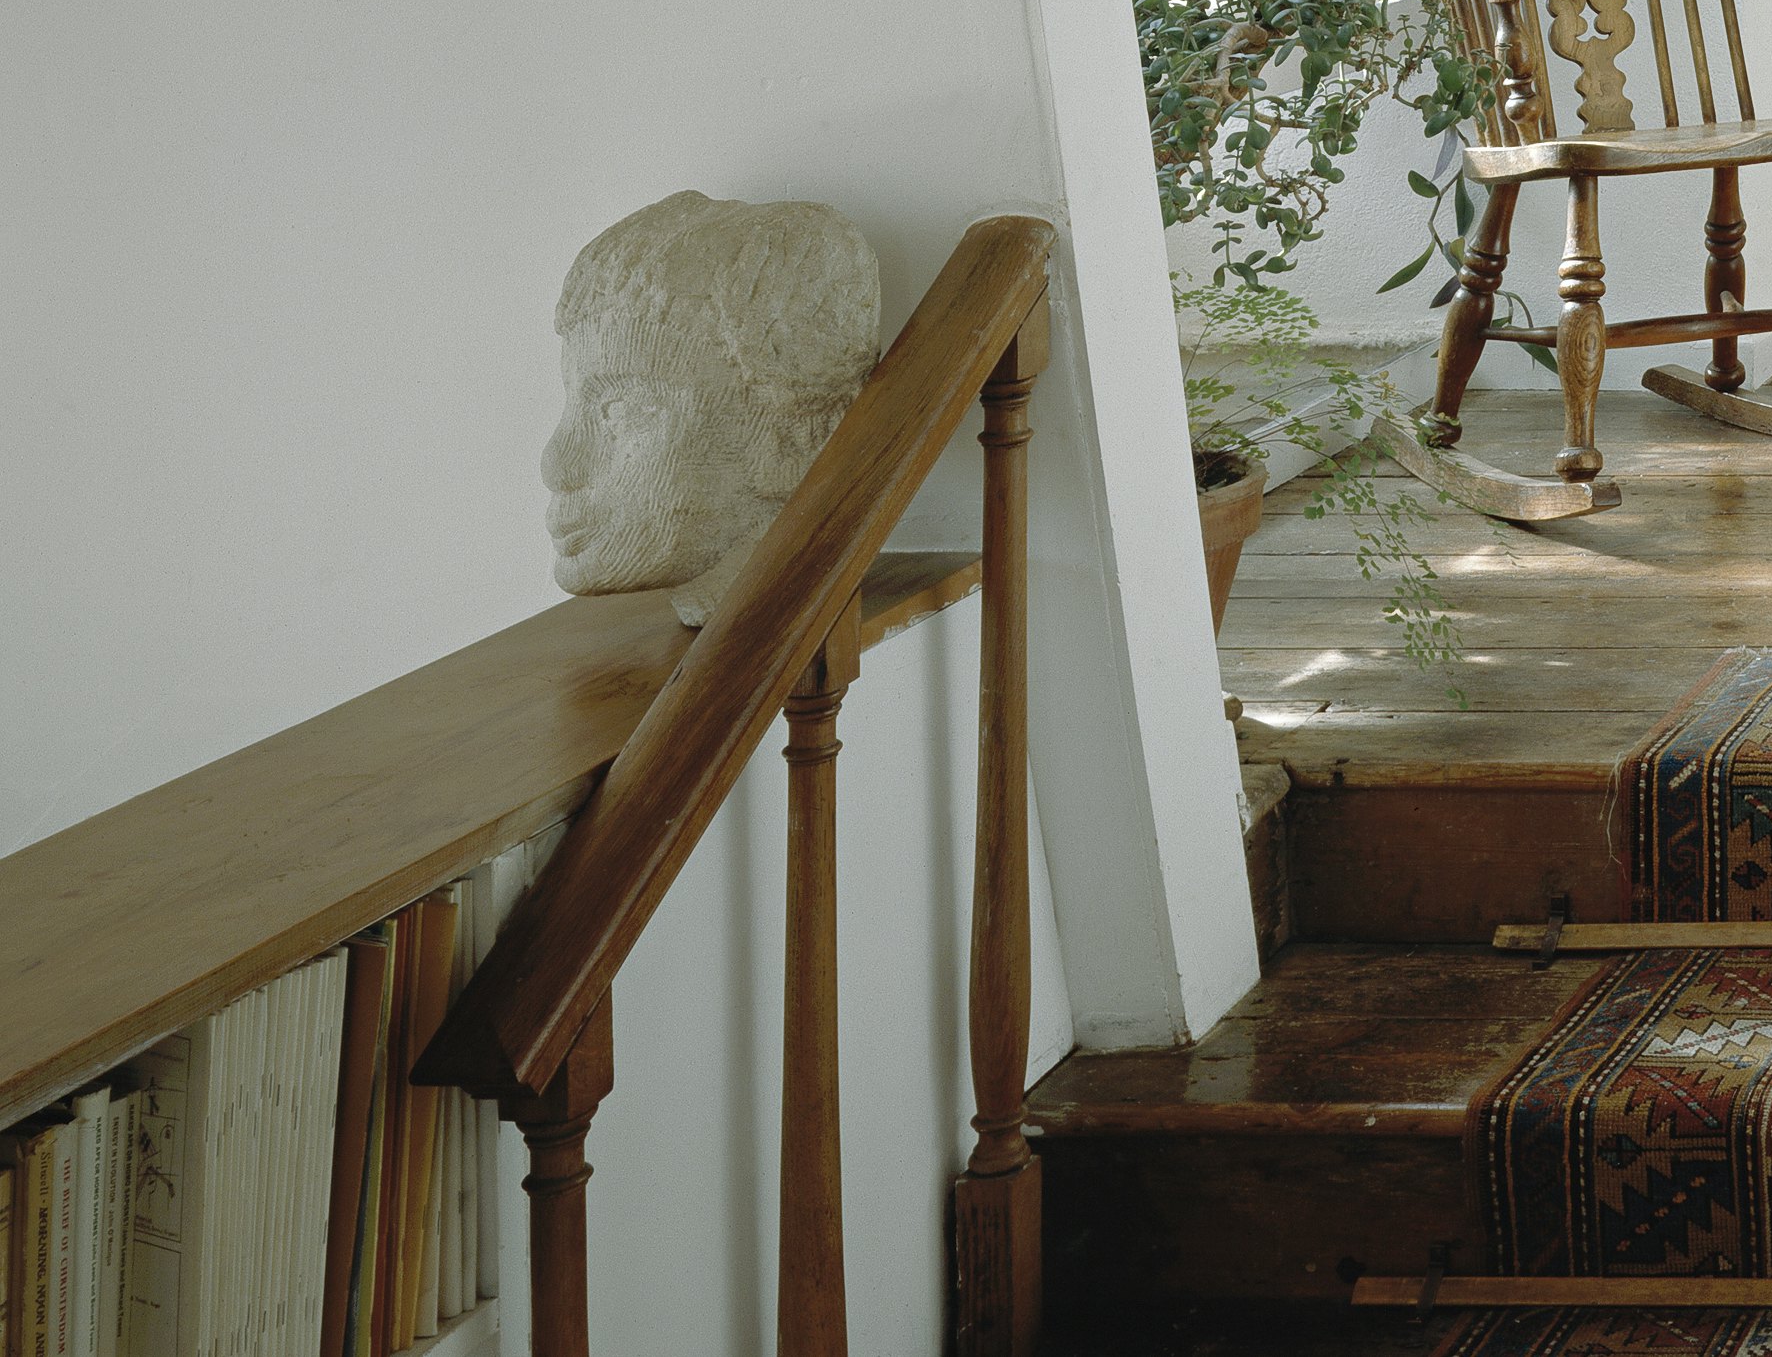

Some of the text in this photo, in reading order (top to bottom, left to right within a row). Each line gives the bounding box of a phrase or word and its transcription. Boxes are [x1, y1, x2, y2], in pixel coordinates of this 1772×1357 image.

[111, 1116, 119, 1147] ENERGY
[94, 1163, 101, 1175] OR
[110, 1148, 118, 1158] IN
[125, 1150, 132, 1162] OR
[39, 1152, 52, 1196] Sitwell
[108, 1159, 117, 1204] EVOLUTION
[57, 1158, 71, 1355] THE BELIEF OF CHRISTENDOM
[35, 1284, 46, 1325] NOON
